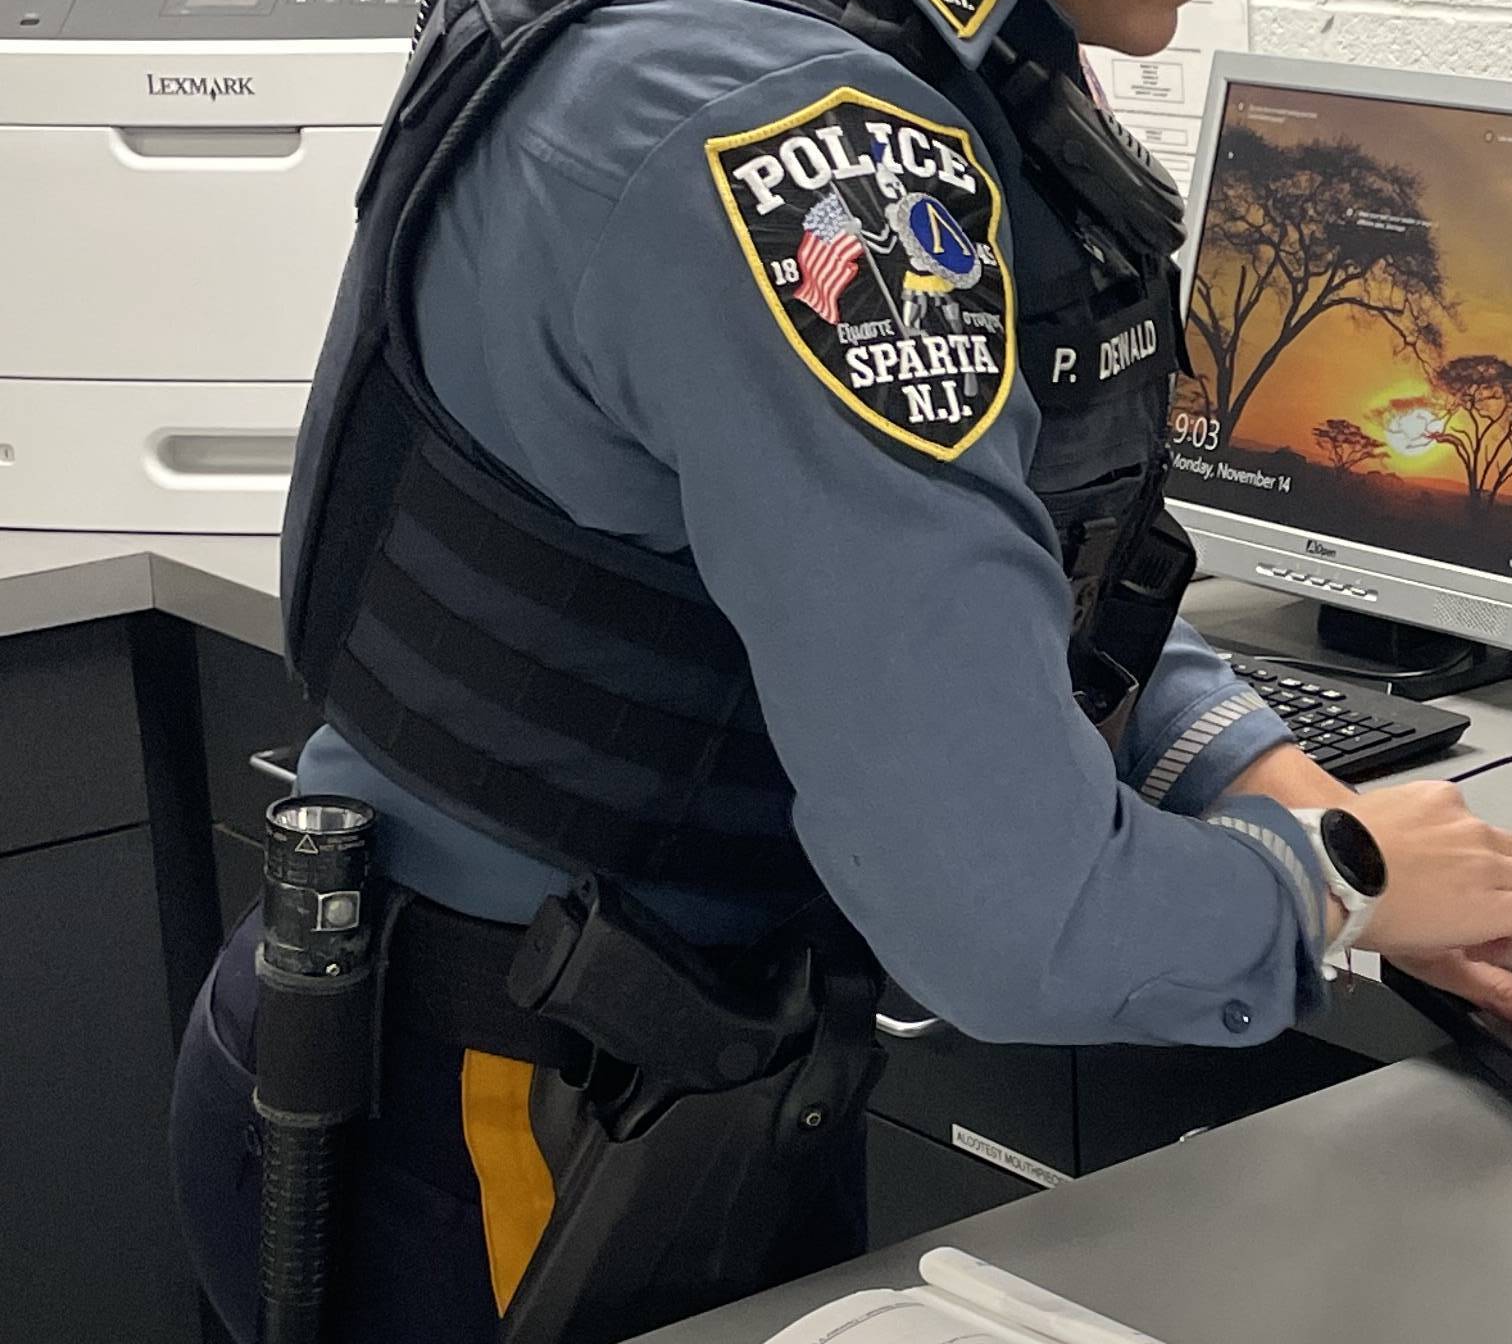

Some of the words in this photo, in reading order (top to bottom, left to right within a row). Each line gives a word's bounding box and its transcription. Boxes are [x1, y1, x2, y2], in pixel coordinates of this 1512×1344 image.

[146, 74, 256, 102] LEXMARK
[733, 122, 977, 216] POLICE
[770, 257, 800, 287] 18
[846, 334, 999, 388] SPARTA
[1052, 348, 1077, 383] P.
[902, 380, 973, 424] N.J.
[1173, 413, 1221, 451] 9:03
[1217, 464, 1277, 490] November
[1278, 475, 1292, 494] 14
